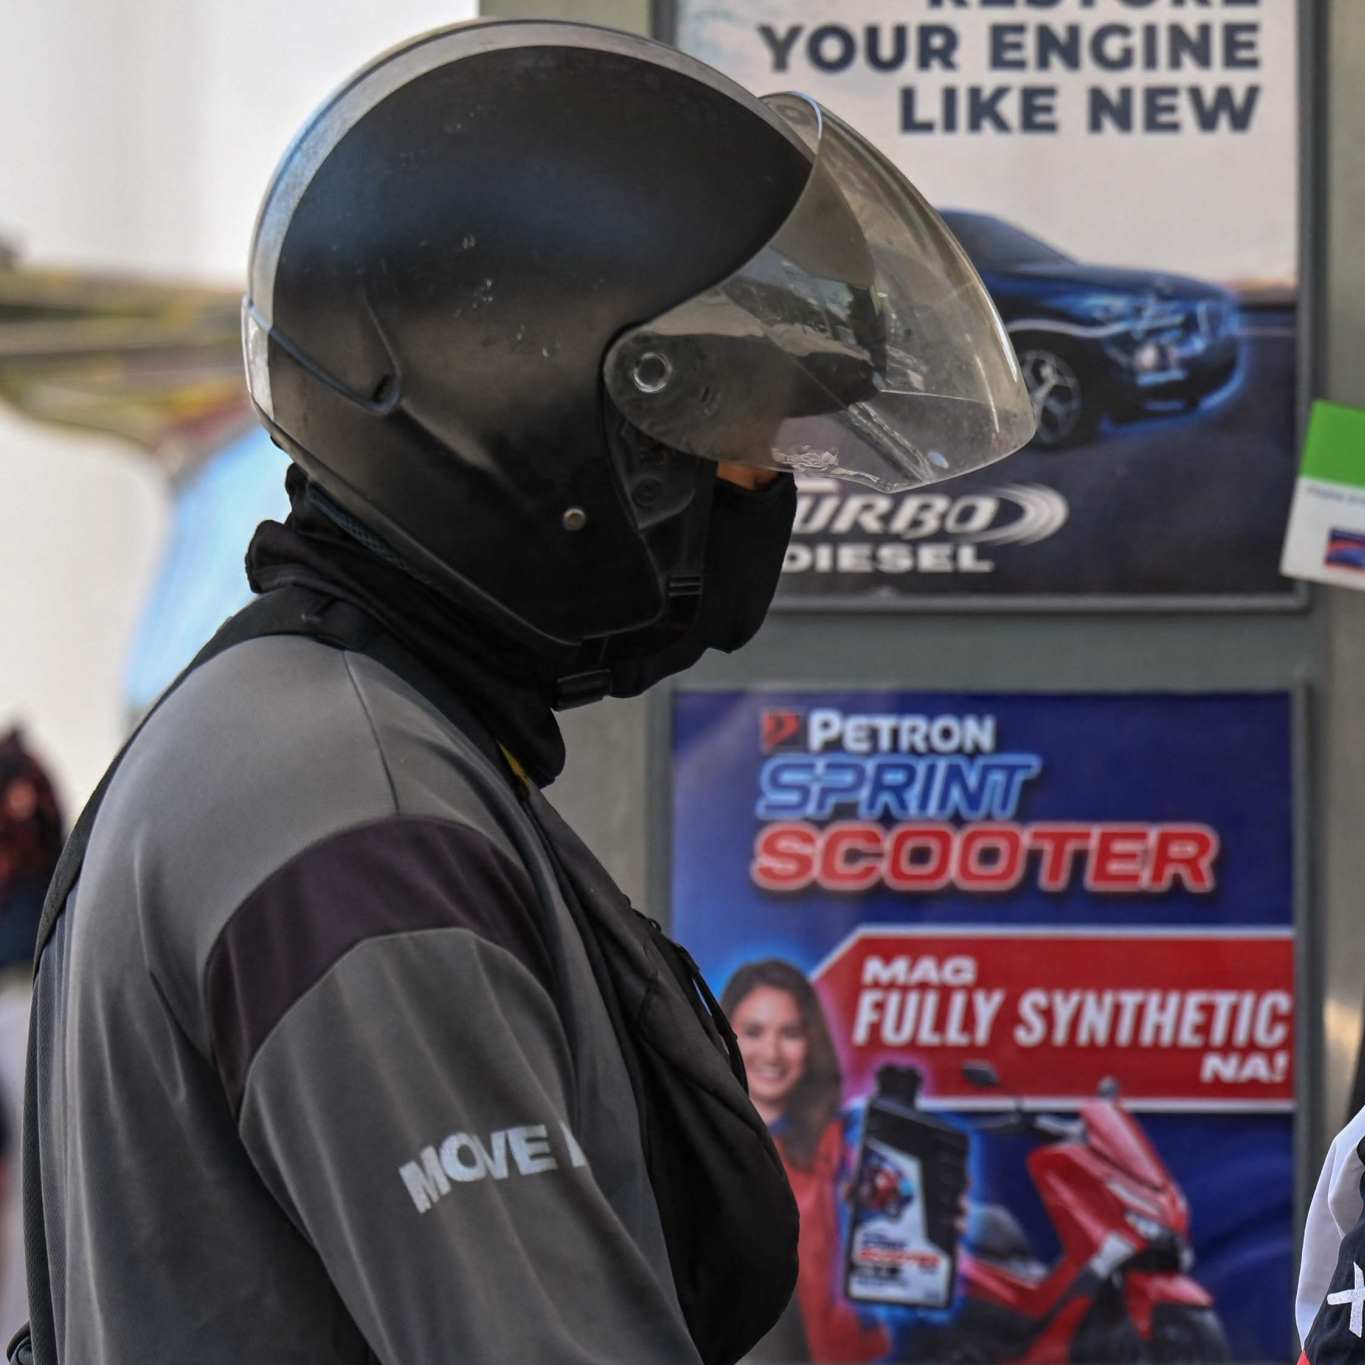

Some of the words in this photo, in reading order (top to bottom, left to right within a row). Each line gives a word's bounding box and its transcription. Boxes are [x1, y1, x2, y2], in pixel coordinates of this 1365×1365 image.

[757, 23, 959, 73] YOUR
[988, 22, 1261, 70] ENGINE
[899, 86, 1057, 134] LIKE
[1088, 85, 1261, 134] NEW
[793, 478, 1000, 539] URBO
[780, 544, 991, 574] DIESEL
[809, 710, 995, 753] PETRON
[755, 754, 1041, 820] SPRINT
[751, 821, 1220, 893] SCOOTER
[862, 956, 977, 985] MAG
[853, 989, 1004, 1047] FULLY
[1014, 990, 1289, 1048] SYNTHETIC
[1200, 1053, 1288, 1083] NA!
[398, 1124, 558, 1215] MOVE
